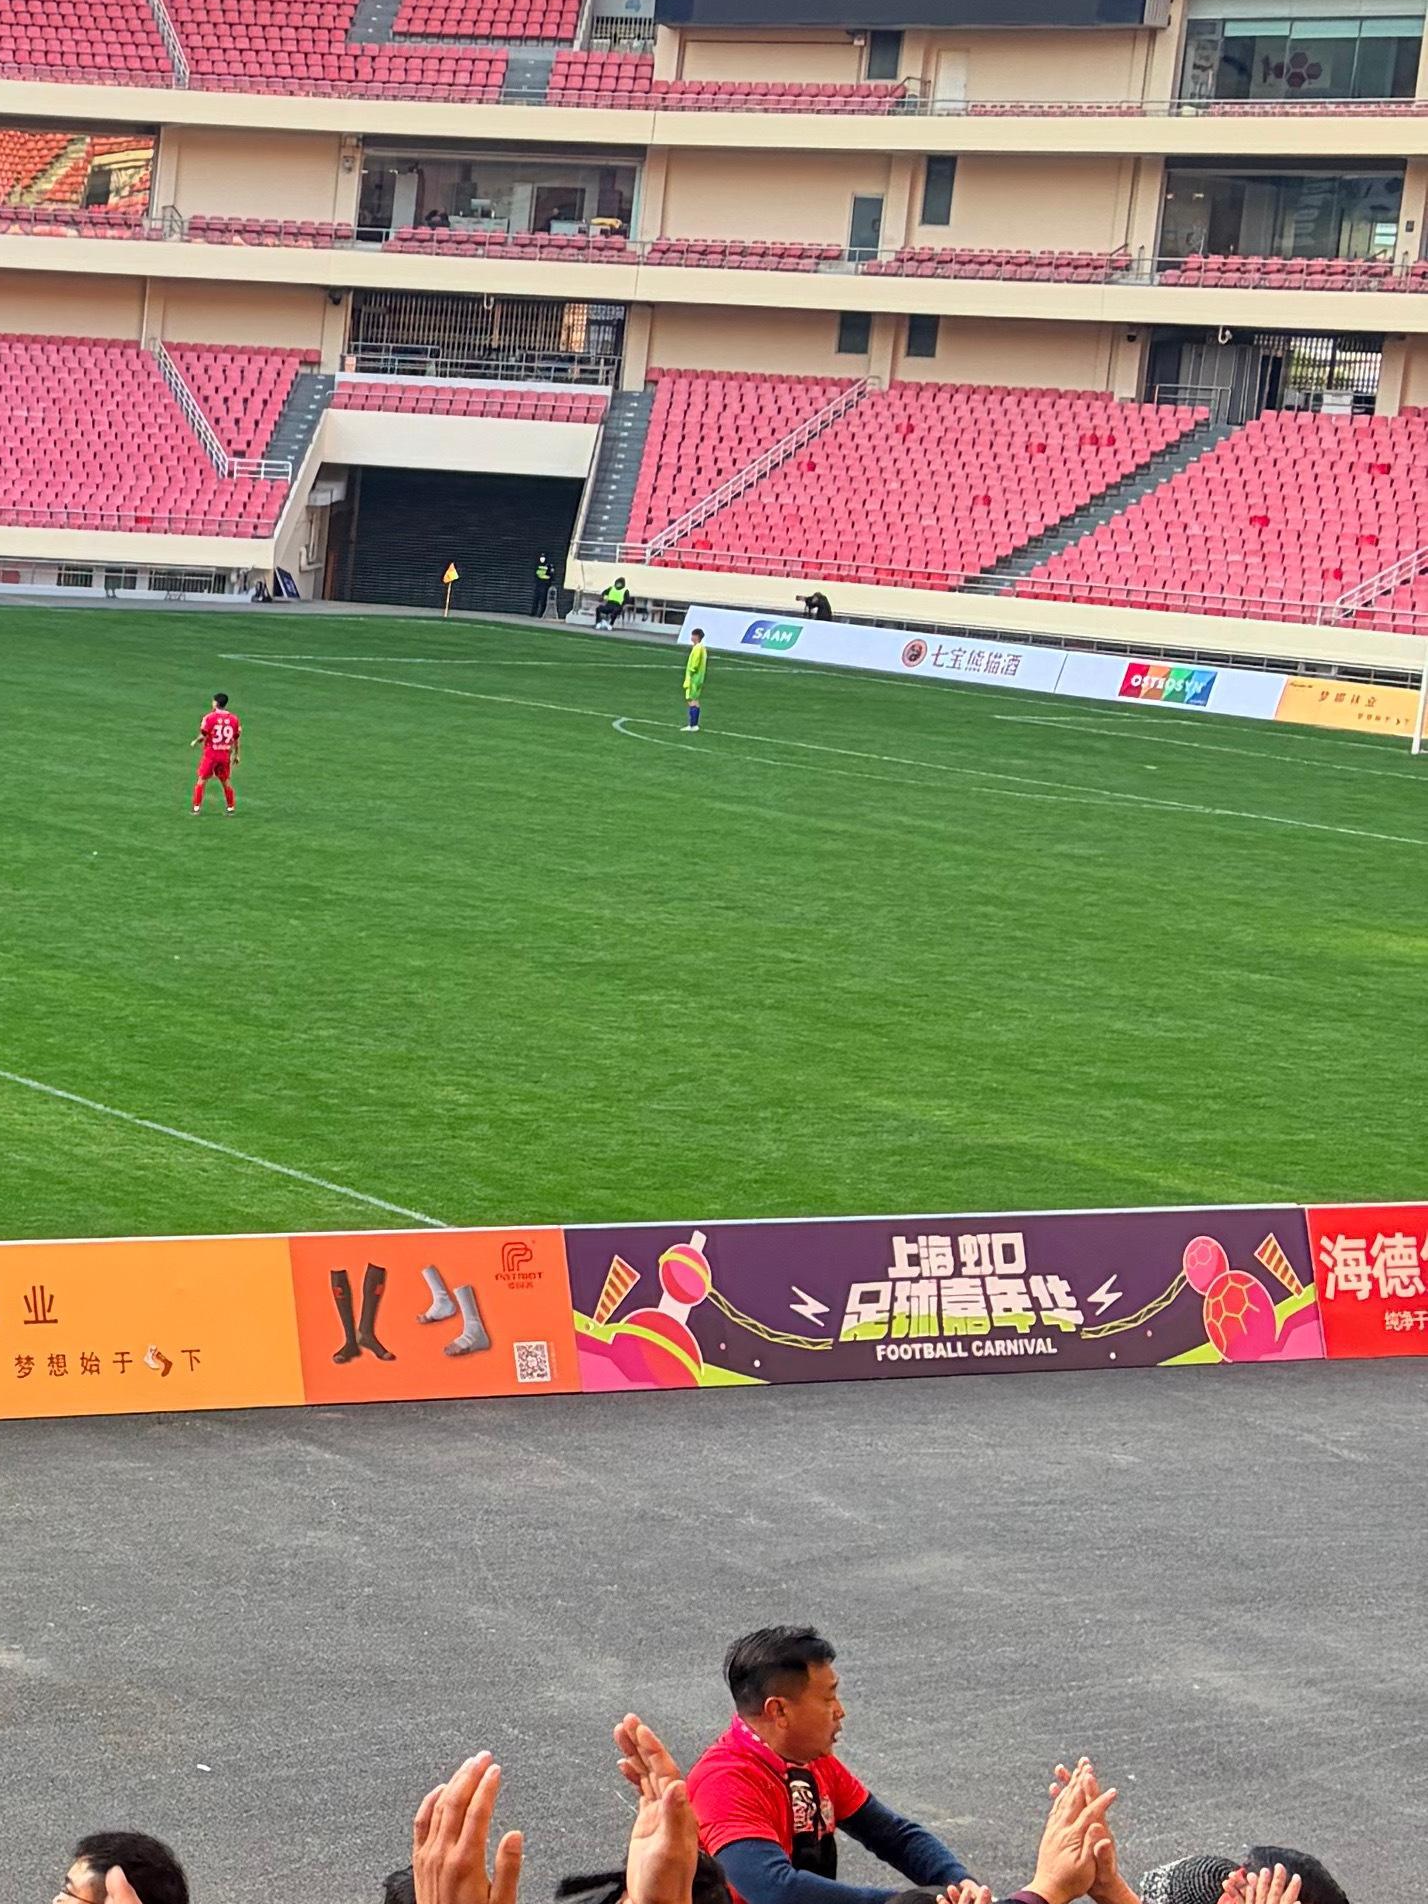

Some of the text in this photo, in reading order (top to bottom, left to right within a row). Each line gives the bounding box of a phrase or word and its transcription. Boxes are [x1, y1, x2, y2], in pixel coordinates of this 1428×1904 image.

[752, 626, 794, 643] SAAM
[930, 644, 1024, 677] 七宝熊猫酒
[212, 725, 233, 744] 39
[1319, 1231, 1428, 1301] 海德
[839, 1274, 1085, 1342] 足球嘉年华
[13, 1350, 134, 1379] 梦想始于
[876, 1338, 1058, 1362] FOOTBALL CARNIVAL
